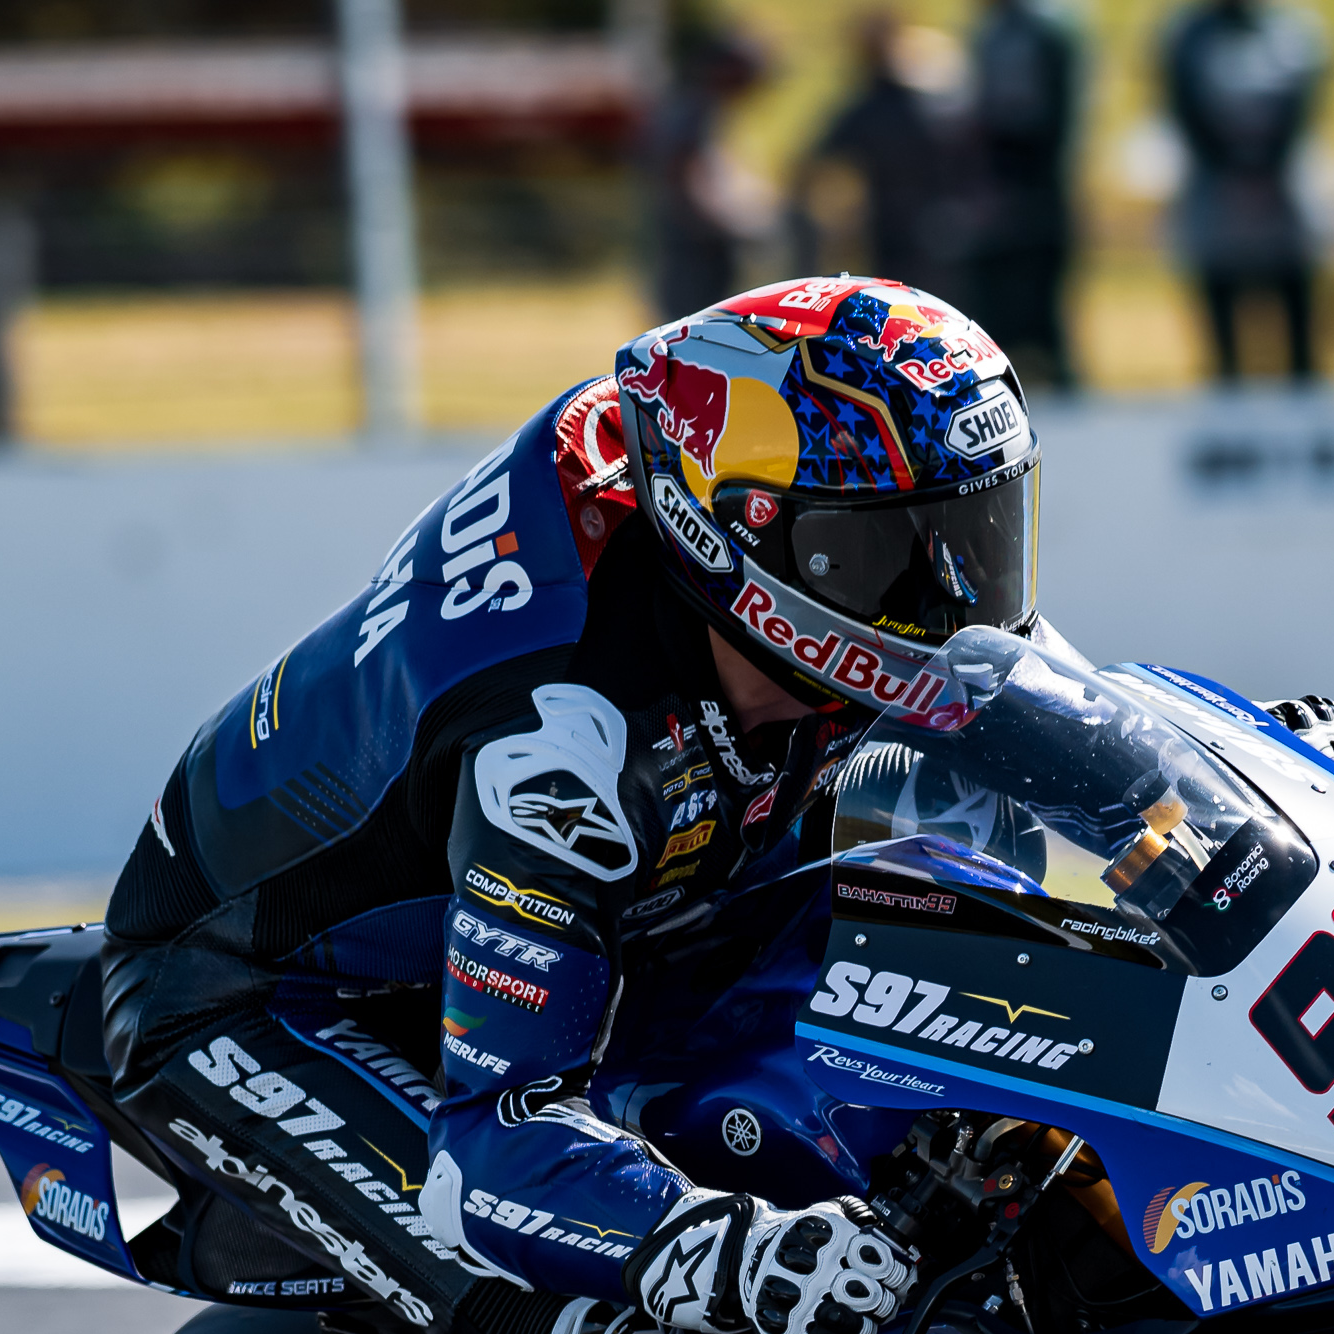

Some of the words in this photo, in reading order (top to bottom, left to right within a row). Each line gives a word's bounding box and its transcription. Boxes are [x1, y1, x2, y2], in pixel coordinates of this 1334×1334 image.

[898, 337, 970, 390] Red
[959, 399, 1018, 449] SHOEI
[958, 478, 998, 496] GIVES
[1004, 463, 1025, 480] YOU
[658, 484, 721, 565] SHOEI
[729, 519, 761, 548] msi
[731, 580, 842, 673] Red
[831, 642, 947, 714] Bull
[465, 869, 575, 925] COMPETITION
[1236, 857, 1269, 893] Racing
[452, 909, 560, 973] GYTR
[448, 943, 550, 1006] MOTORSPORT
[485, 985, 541, 1014] SERVICE
[807, 1044, 864, 1070] Revs
[859, 1062, 903, 1084] Your
[900, 1073, 947, 1094] Heart
[280, 1277, 345, 1295] SEATS
